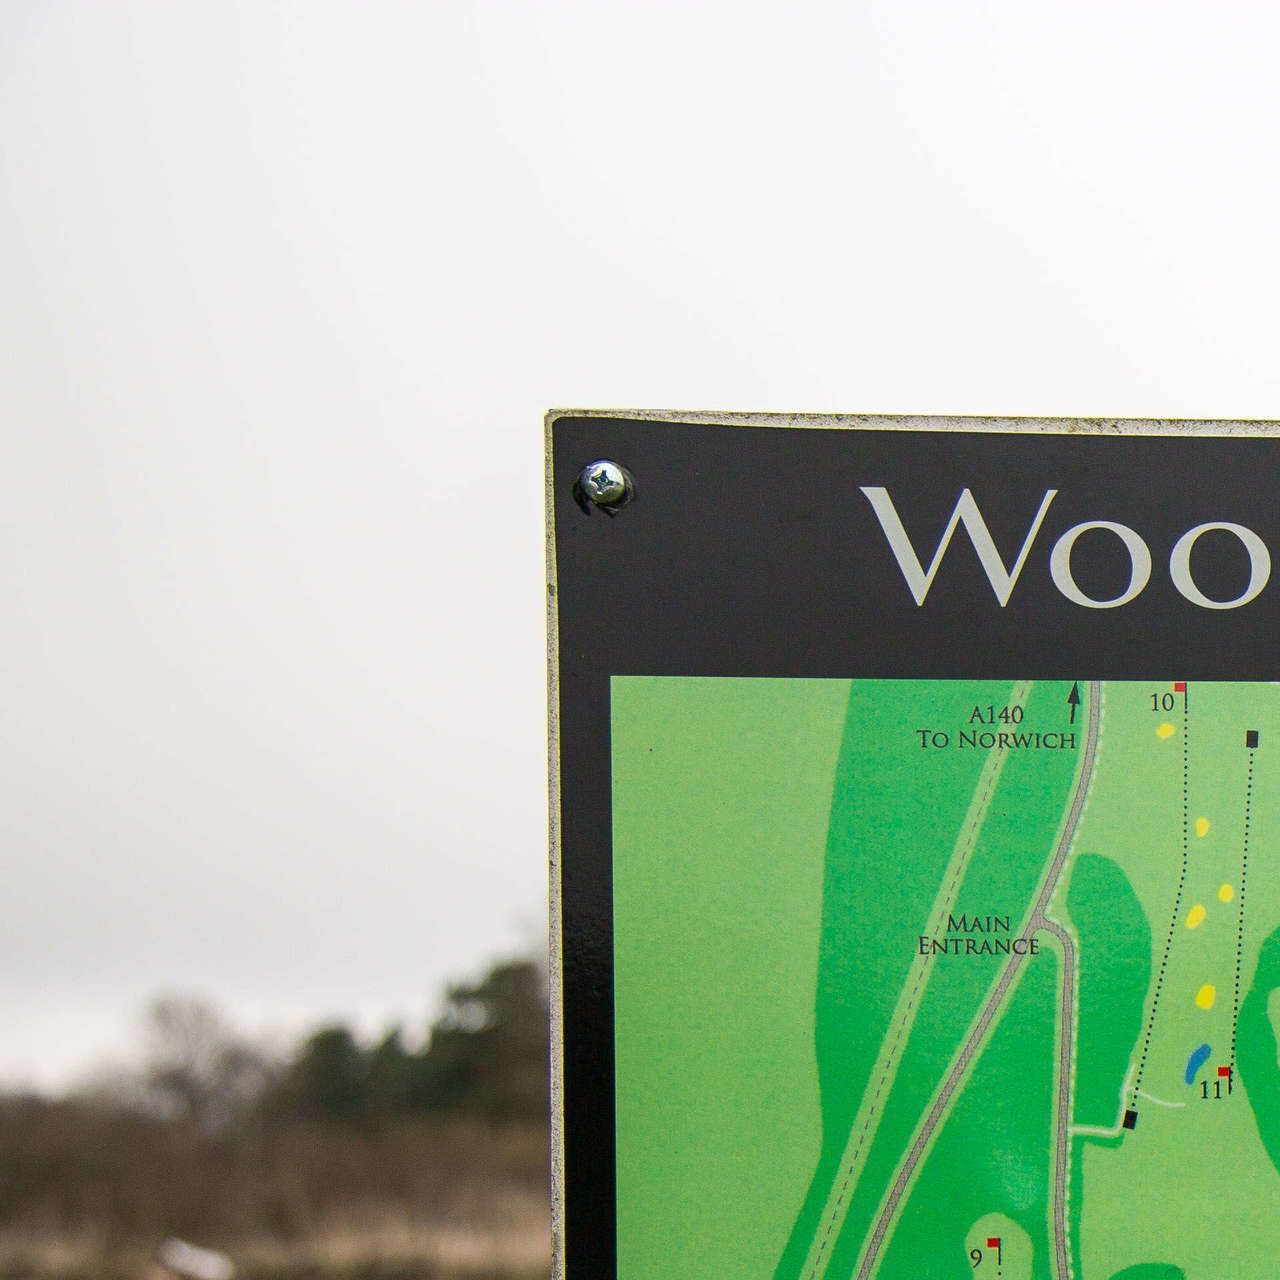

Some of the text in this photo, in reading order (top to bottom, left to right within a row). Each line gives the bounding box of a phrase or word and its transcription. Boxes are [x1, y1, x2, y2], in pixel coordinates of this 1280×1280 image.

[1151, 693, 1174, 711] 10
[969, 705, 1023, 724] A140
[916, 730, 1075, 749] TO NORWICH
[947, 914, 1009, 932] MAIN
[919, 936, 1039, 955] ENTRANCE
[1201, 1080, 1221, 1099] 11
[970, 1249, 982, 1268] 9
